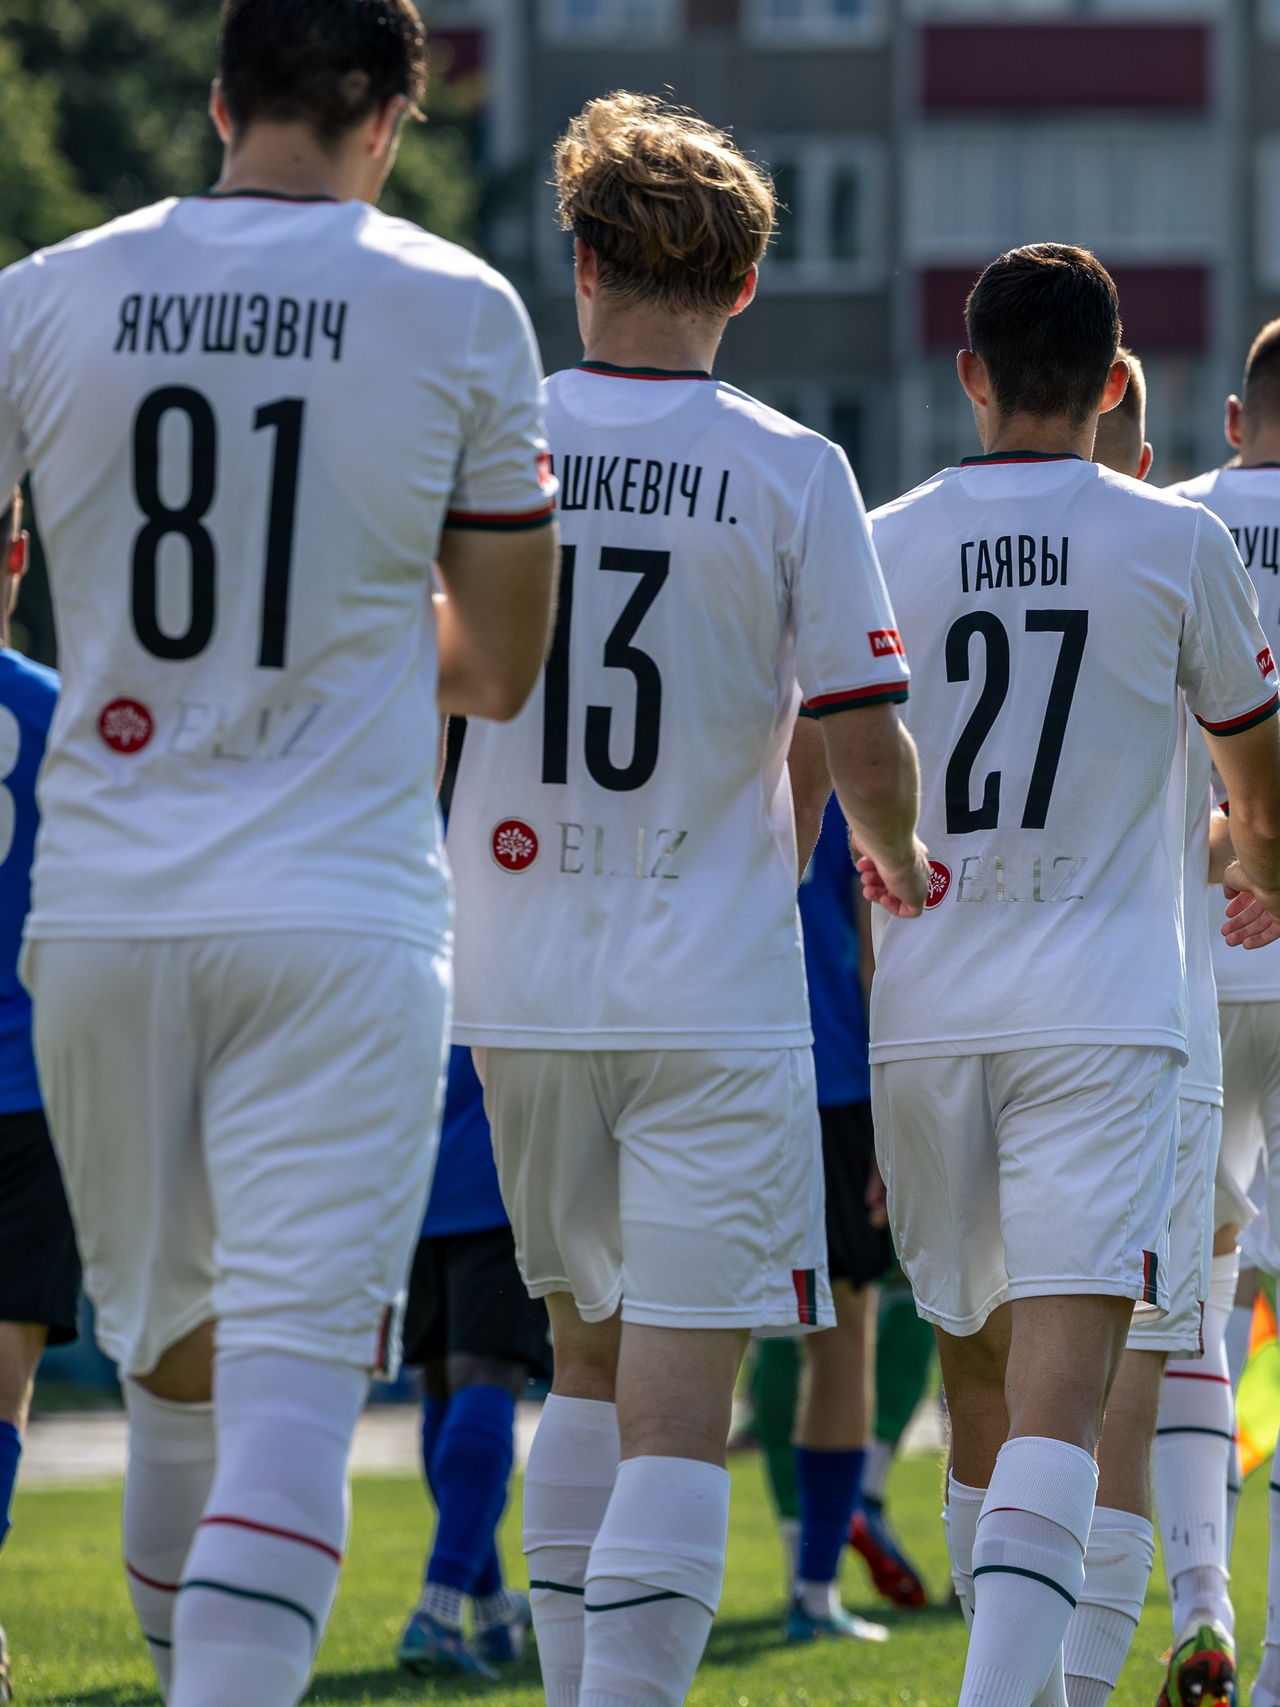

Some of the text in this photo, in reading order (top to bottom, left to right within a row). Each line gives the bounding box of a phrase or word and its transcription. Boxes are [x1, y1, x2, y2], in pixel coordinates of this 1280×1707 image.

[113, 292, 349, 362] ЯКУШЭВІЧ
[550, 453, 703, 518] ШКЕВІЧ
[130, 383, 307, 670] 81
[959, 533, 1070, 593] ГАЯВЫ
[541, 543, 671, 792] 13
[945, 609, 1090, 835] 27
[555, 821, 689, 880] ELIZ
[955, 855, 1089, 903] ELIZ
